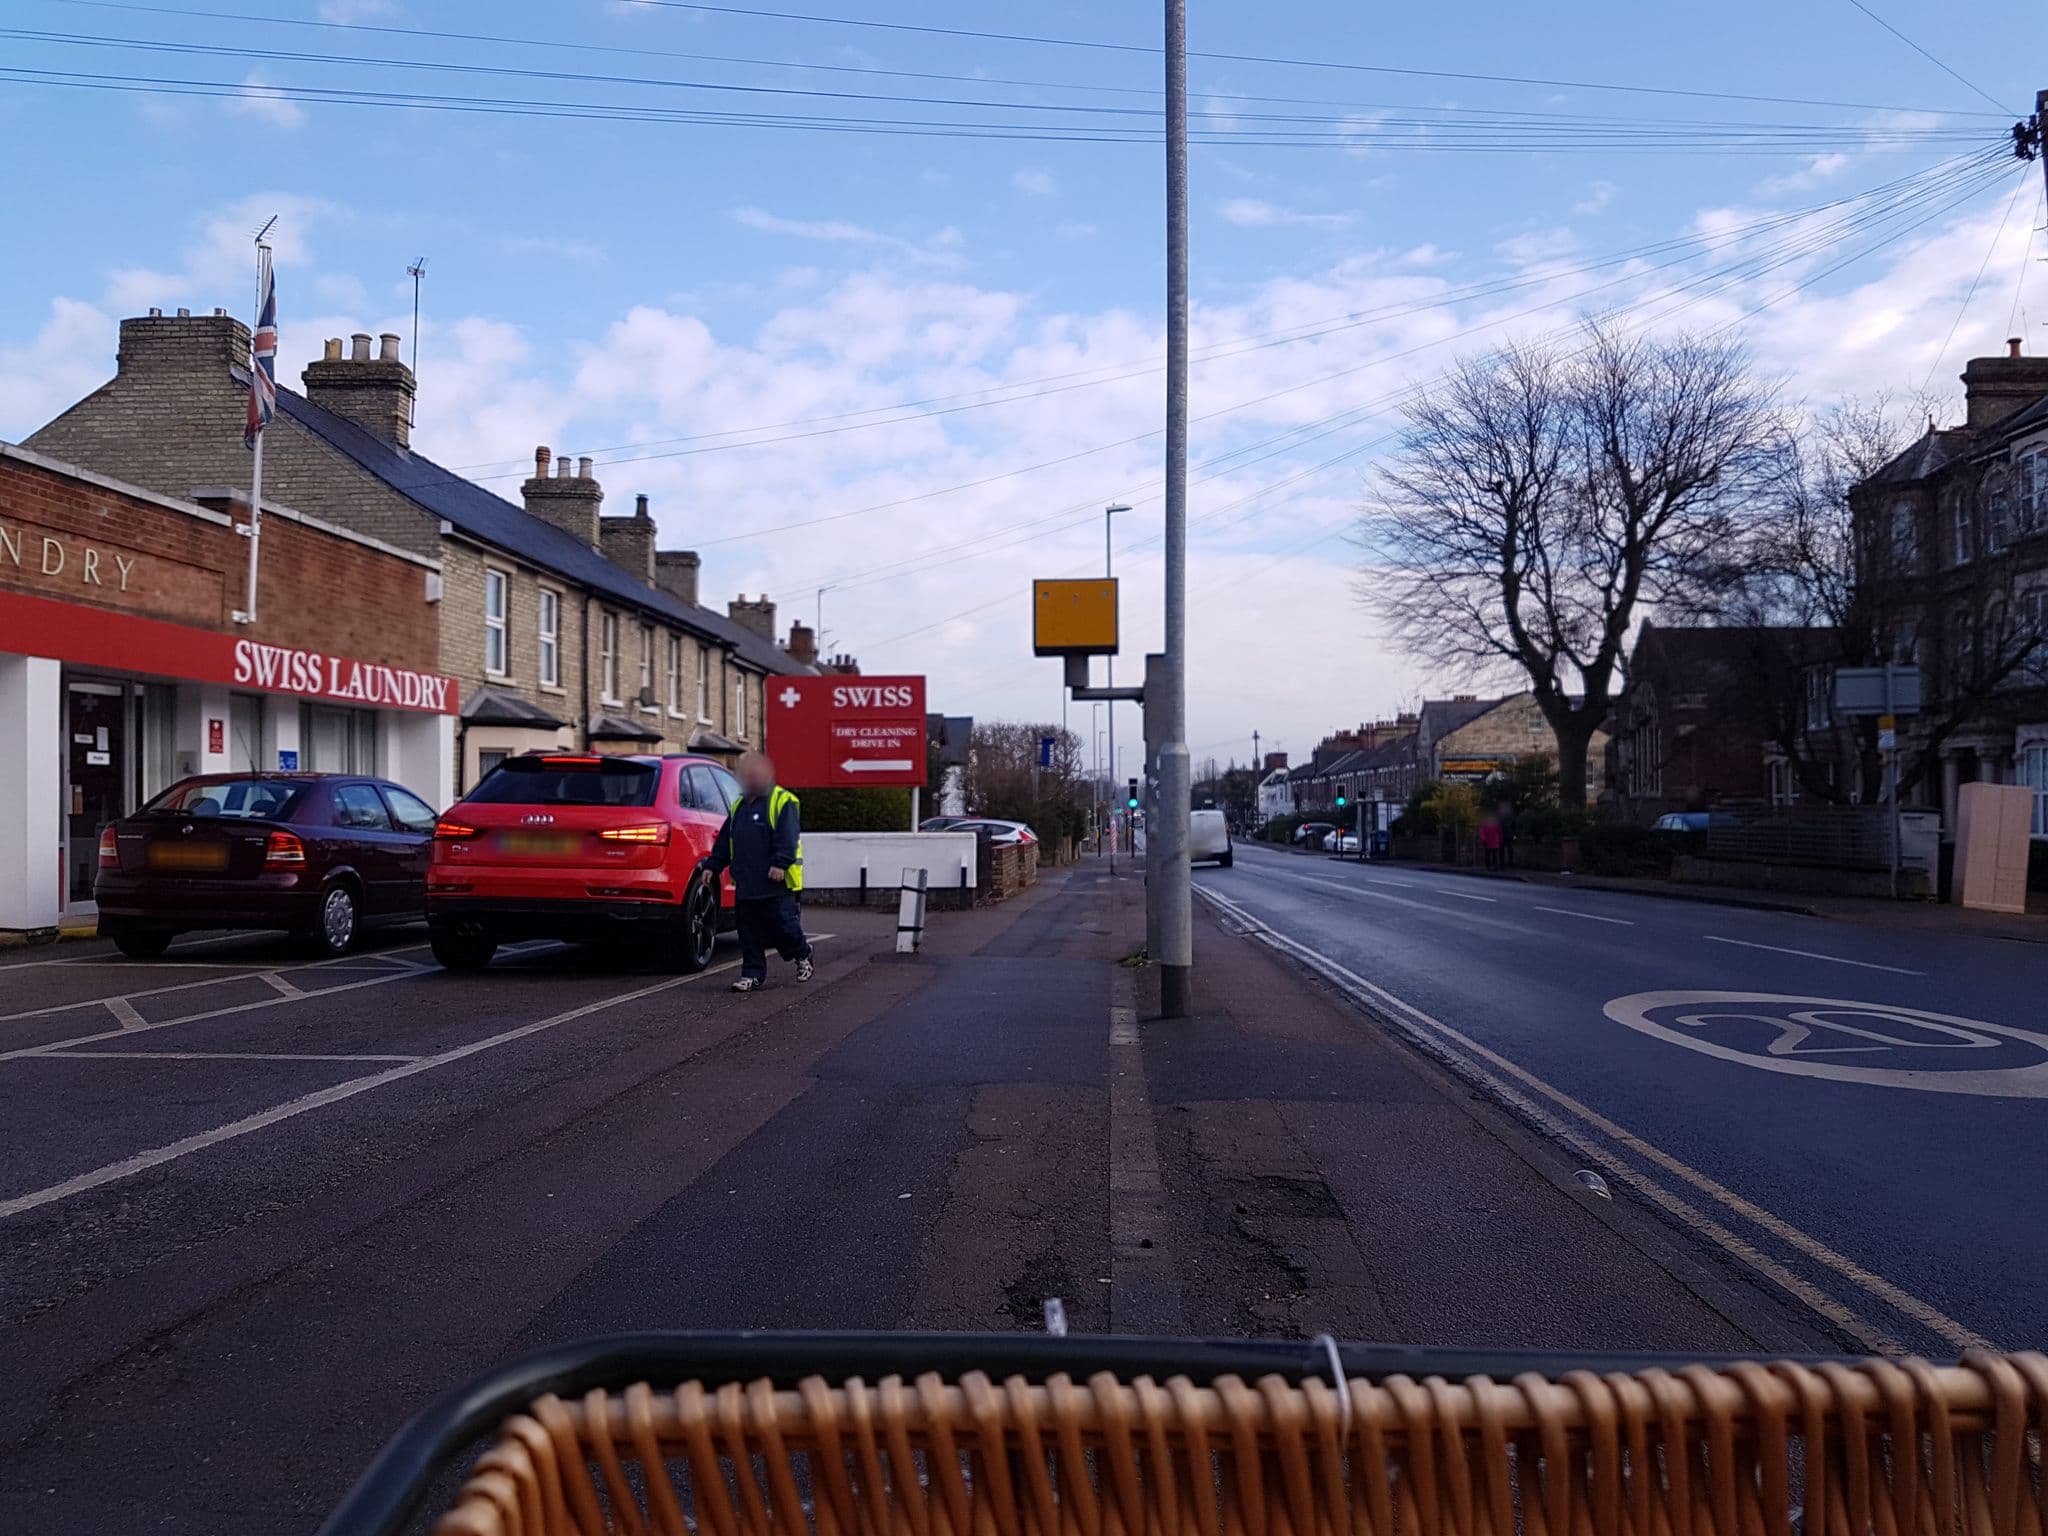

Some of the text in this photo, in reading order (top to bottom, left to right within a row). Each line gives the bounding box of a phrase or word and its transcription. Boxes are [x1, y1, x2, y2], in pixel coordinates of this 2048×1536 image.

[234, 639, 449, 711] SWISS LAUNDRY
[833, 686, 913, 707] SWISS
[836, 727, 918, 737] DRY CLEANING
[851, 738, 902, 748] DRIVE IN
[1675, 1011, 2002, 1055] 20
